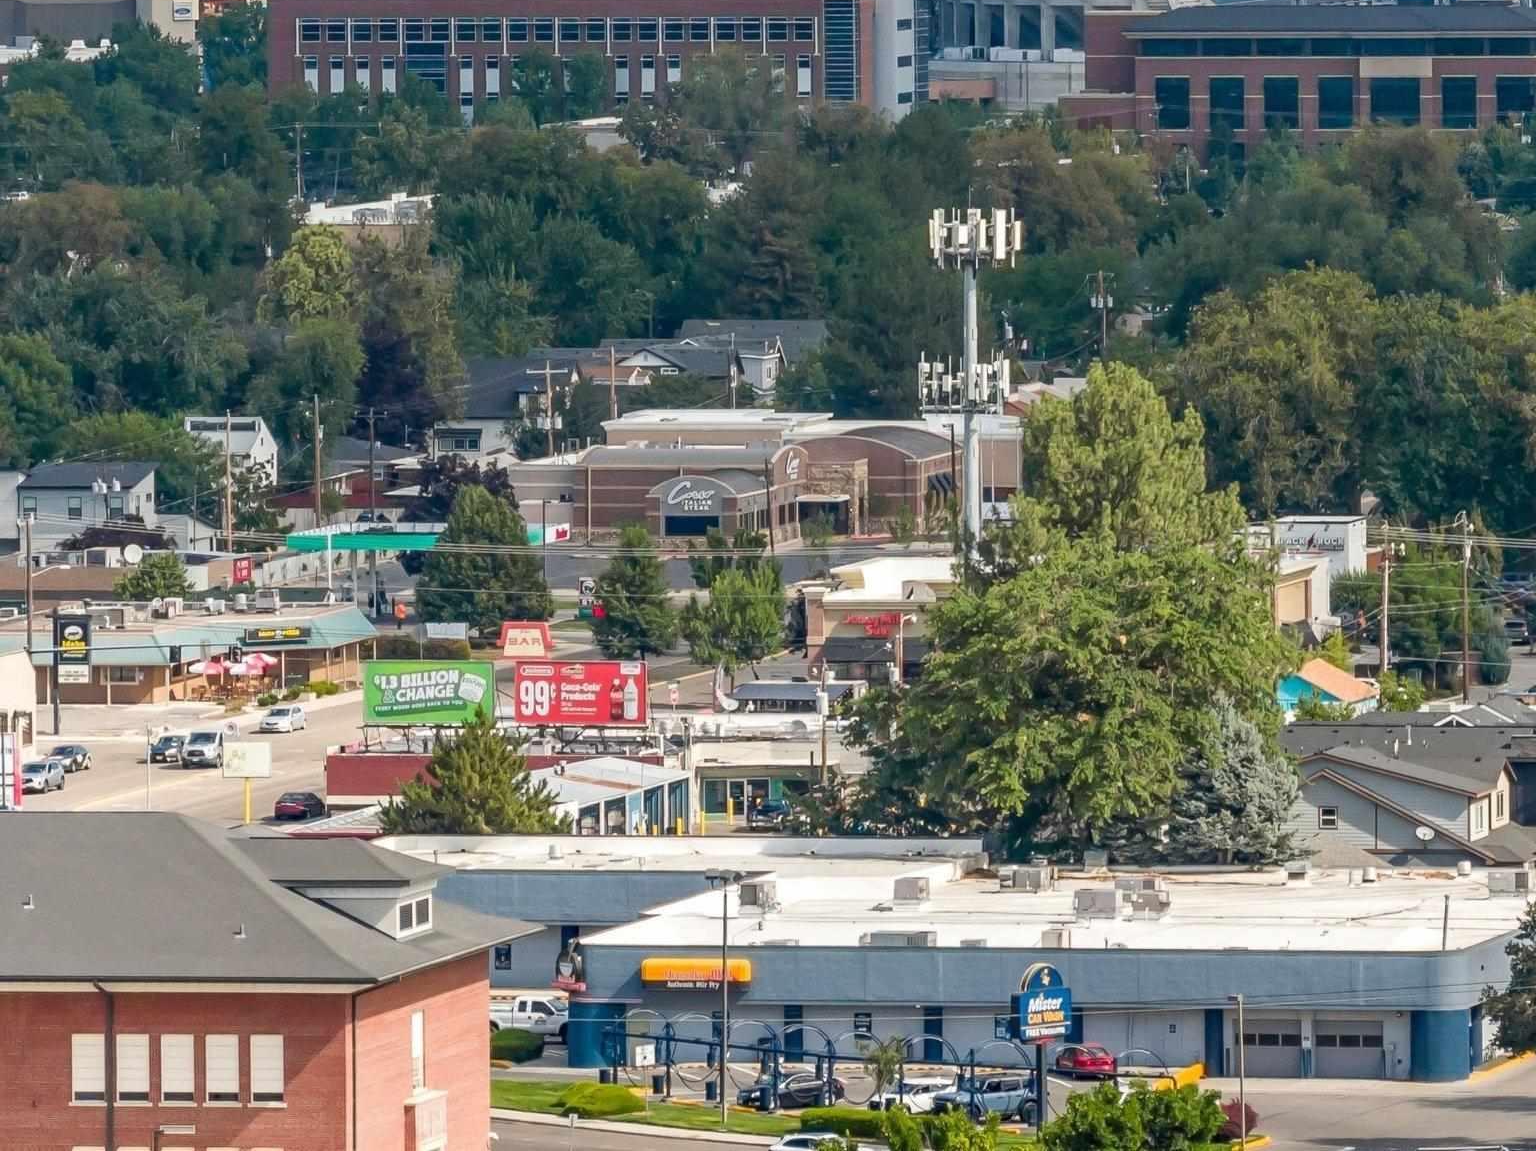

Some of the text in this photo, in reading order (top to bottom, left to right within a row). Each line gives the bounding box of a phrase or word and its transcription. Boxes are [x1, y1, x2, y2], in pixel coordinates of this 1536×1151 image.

[508, 637, 542, 646] BAR
[374, 675, 398, 690] $1.3
[401, 670, 460, 689] BILLION
[395, 684, 455, 703] CHANGE
[560, 691, 597, 701] Products
[709, 980, 720, 990] Fry
[1028, 993, 1063, 1013] Mister
[1028, 1010, 1065, 1025] CAR WASH
